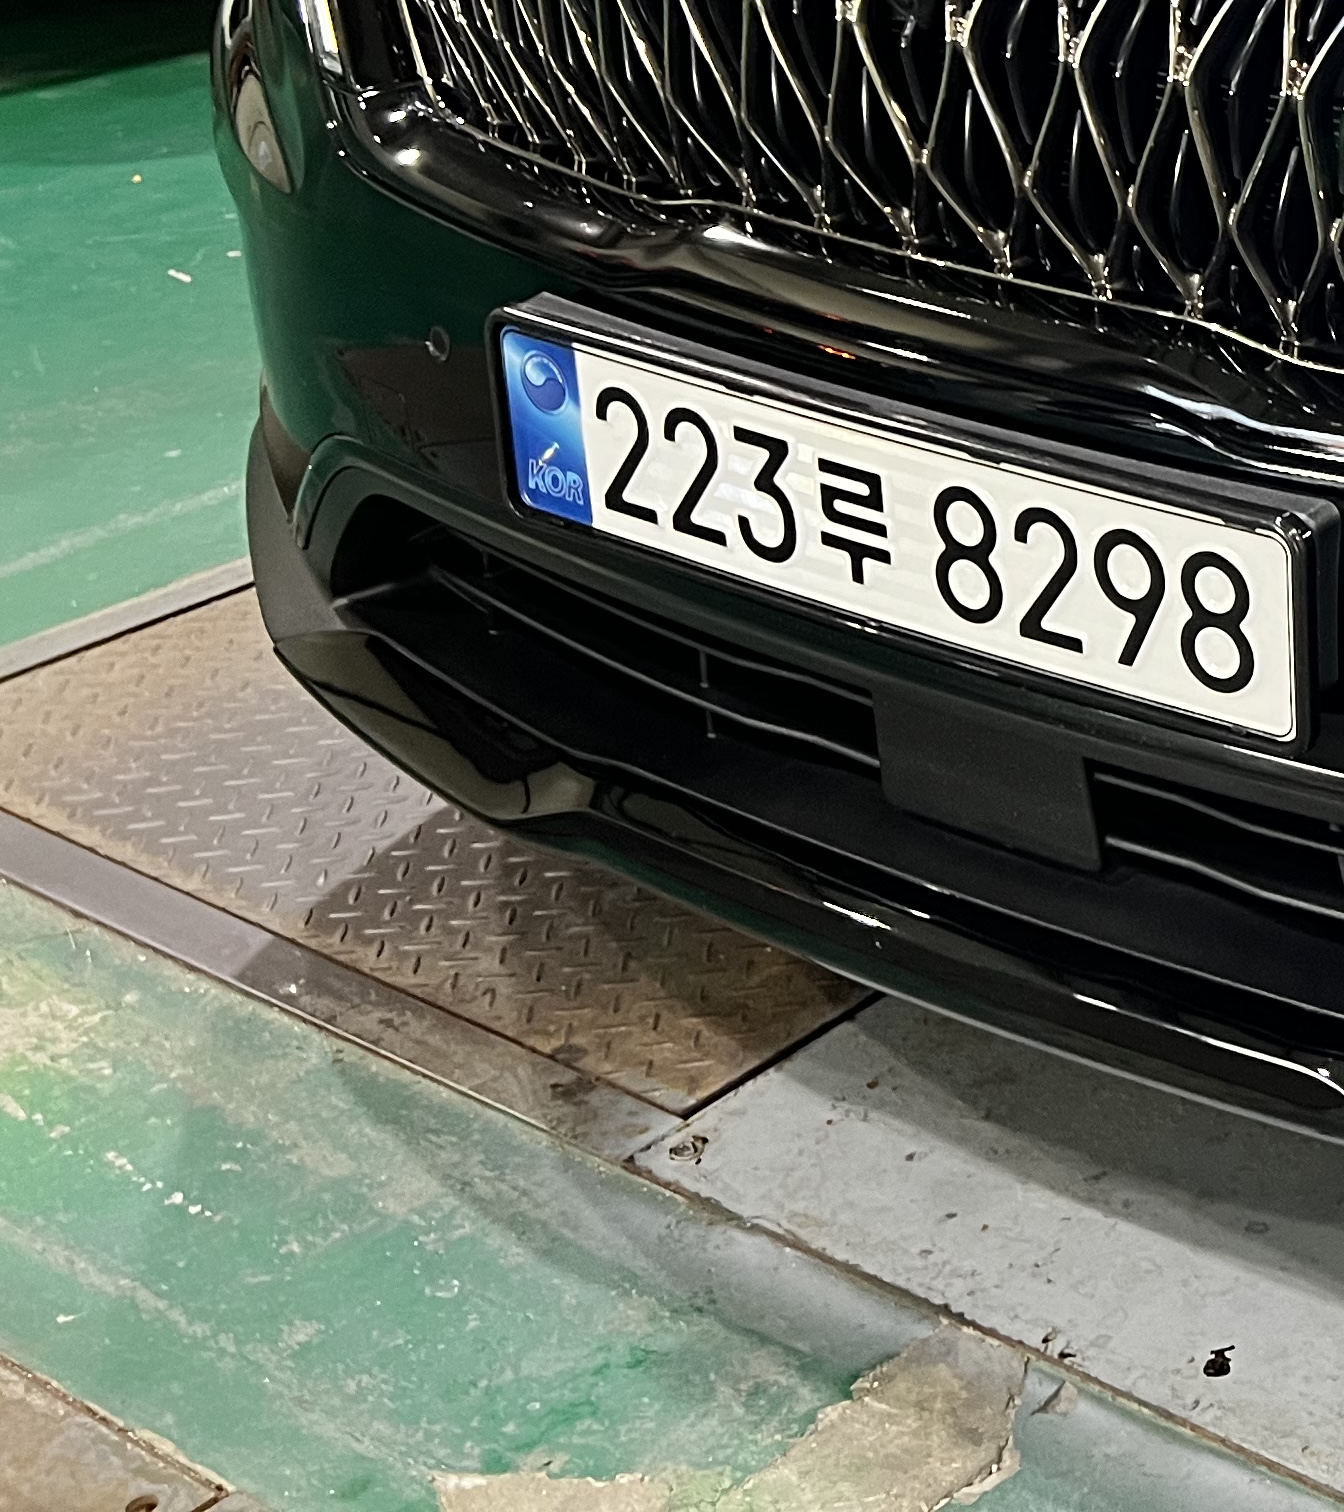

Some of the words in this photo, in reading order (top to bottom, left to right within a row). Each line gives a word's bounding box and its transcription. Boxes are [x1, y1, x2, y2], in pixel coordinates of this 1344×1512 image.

[528, 458, 584, 505] KOR
[595, 386, 892, 585] 223루
[932, 485, 1255, 693] 8298
